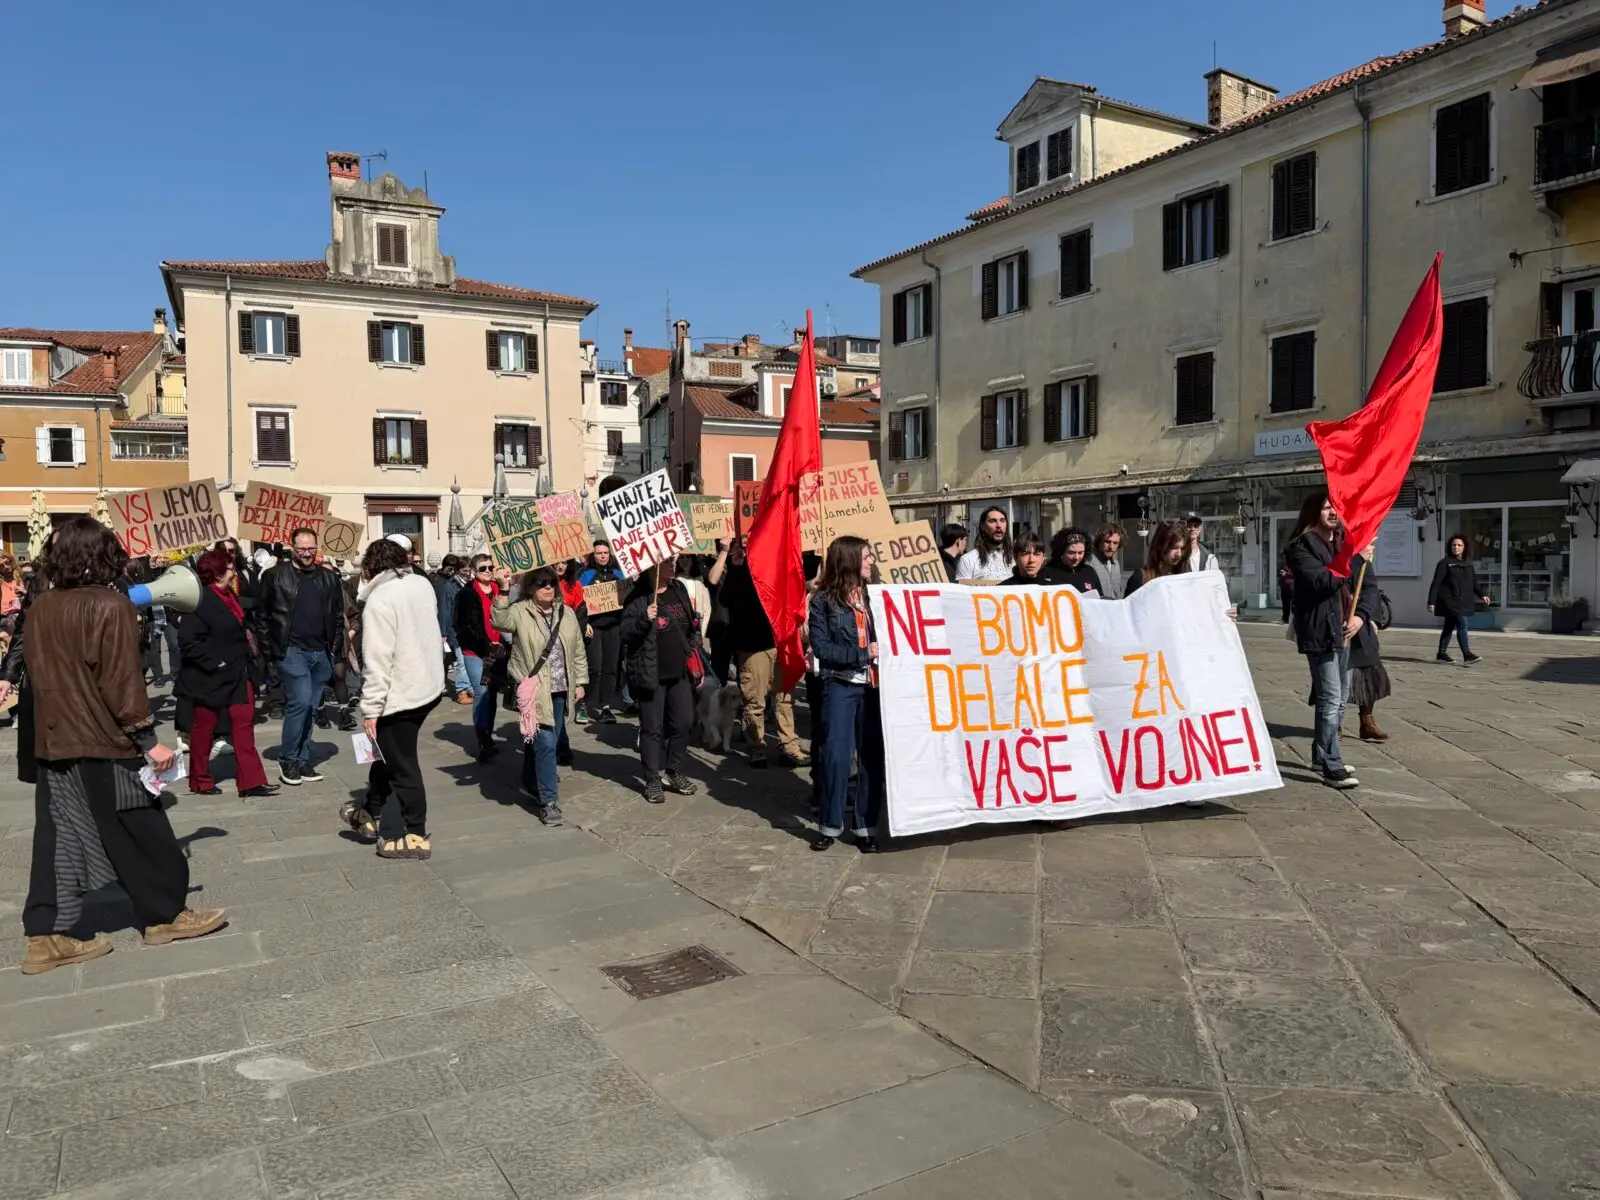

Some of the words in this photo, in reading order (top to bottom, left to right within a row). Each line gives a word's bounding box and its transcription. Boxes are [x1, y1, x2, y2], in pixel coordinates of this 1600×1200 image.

[828, 466, 869, 486] JUST
[842, 481, 880, 499] HAVE
[112, 492, 154, 524] VSI
[160, 484, 214, 518] JEMO,
[256, 488, 289, 510] DAN
[597, 480, 655, 520] NEHAJTE
[658, 474, 670, 492] Z
[612, 492, 678, 533] VOJNAMI
[692, 504, 704, 515] HOT
[708, 504, 730, 514] PEOPLE
[115, 524, 152, 556] VSI
[154, 514, 228, 550] KUHAJMO
[242, 506, 280, 528] DELA
[283, 513, 325, 536] PROST
[482, 501, 542, 542] MAKE
[612, 527, 645, 553] DAJTE
[646, 510, 684, 537] LJUDEM
[492, 528, 546, 574] NOT
[544, 522, 590, 559] WAR
[618, 550, 636, 575] PACE
[629, 530, 684, 573] MIR
[889, 534, 936, 560] DELO,
[890, 559, 944, 584] PROFIT
[882, 590, 951, 656] NE
[972, 590, 1085, 656] BOMO
[925, 659, 1094, 732] DELALE
[1122, 650, 1185, 720] ZA
[964, 728, 1078, 809] VAŠE
[1099, 708, 1263, 794] VOJNE!
